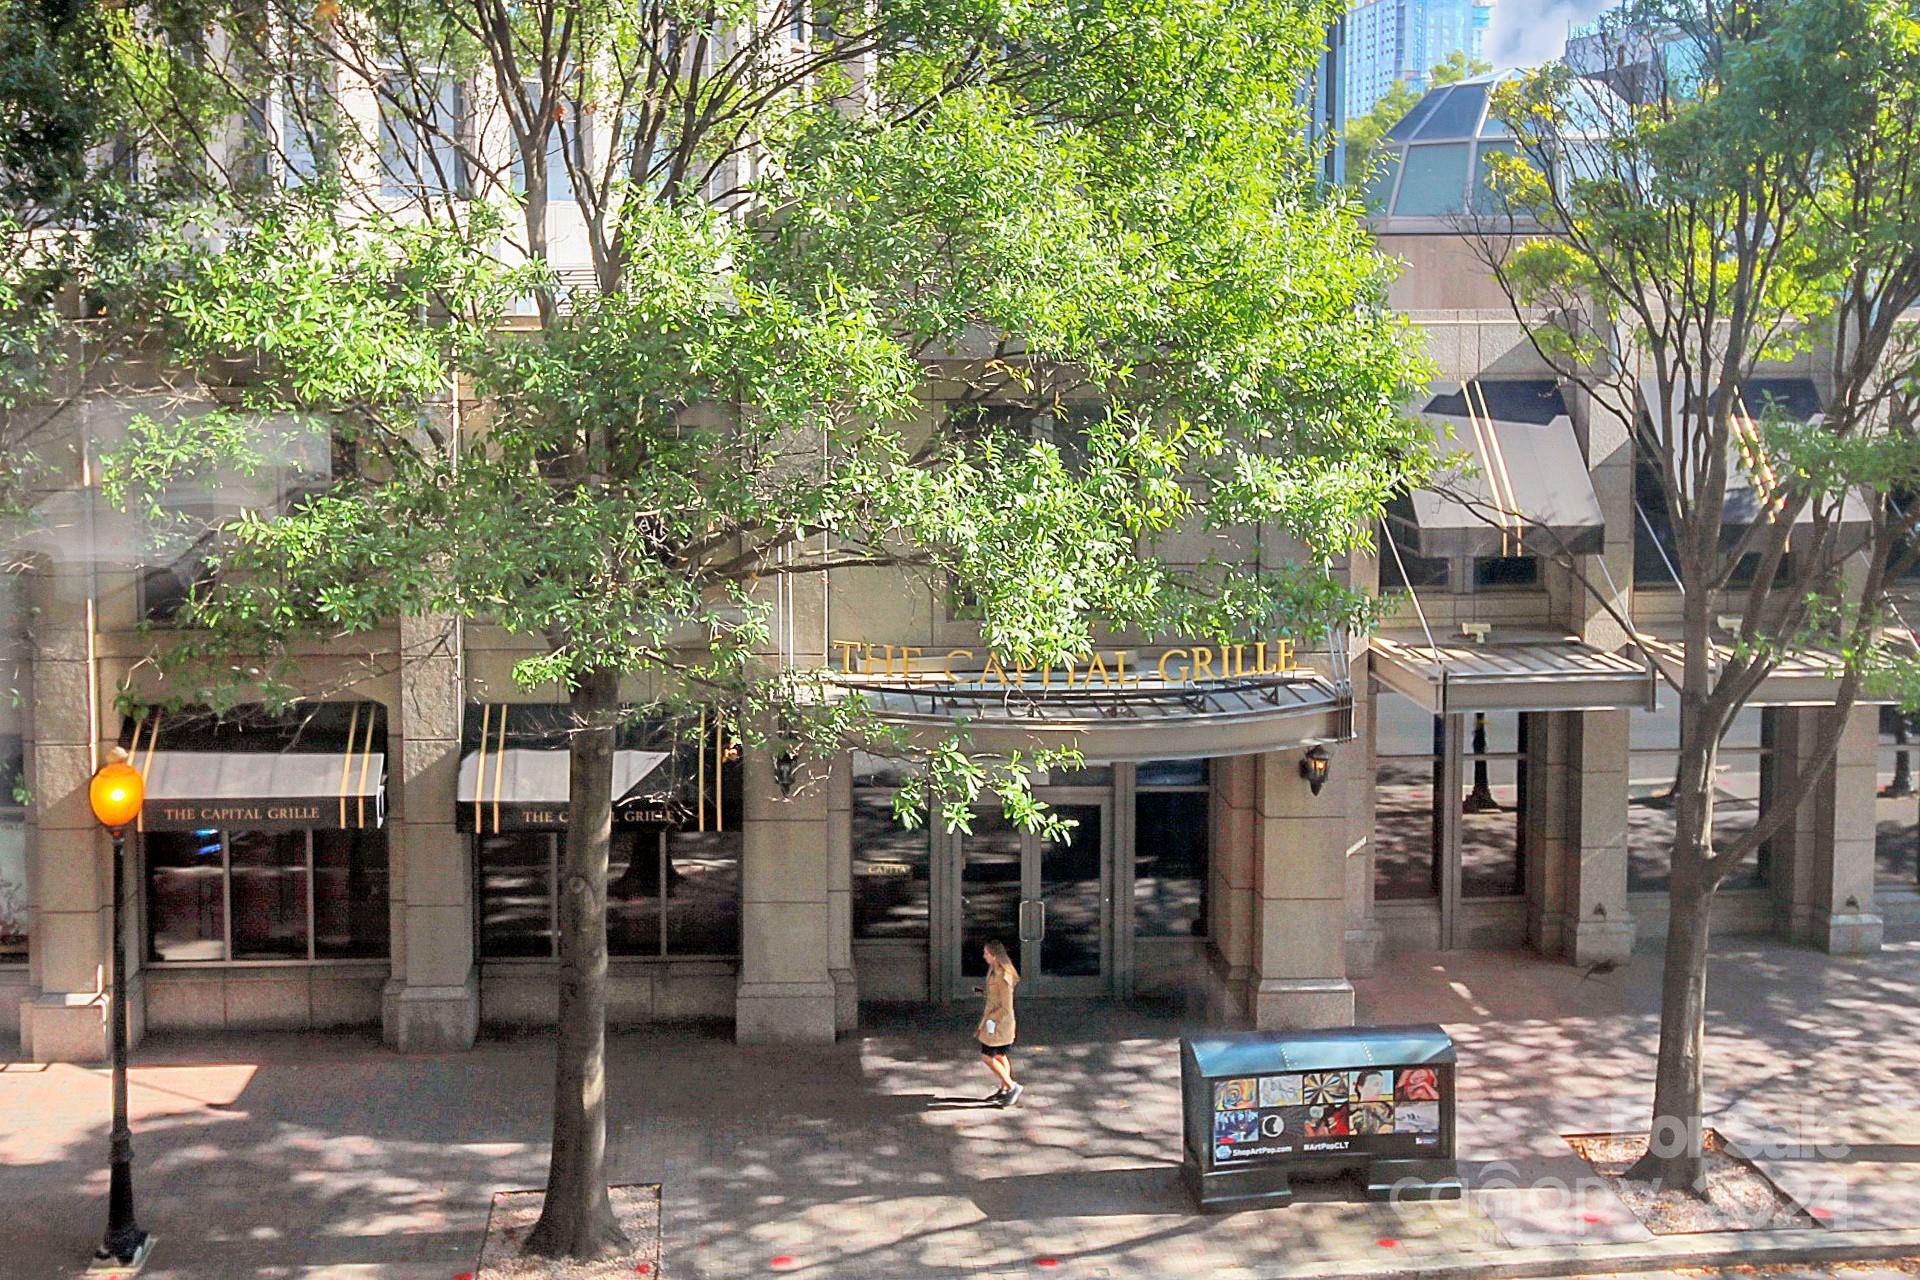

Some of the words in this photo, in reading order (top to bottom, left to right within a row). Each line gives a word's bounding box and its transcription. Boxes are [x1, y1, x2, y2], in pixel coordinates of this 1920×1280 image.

[833, 640, 922, 679] THE
[1158, 638, 1298, 682] GRILLE
[164, 808, 196, 820] THE
[201, 808, 262, 820] CAPITAL
[267, 807, 320, 820] GRILLE
[522, 811, 553, 823] THE
